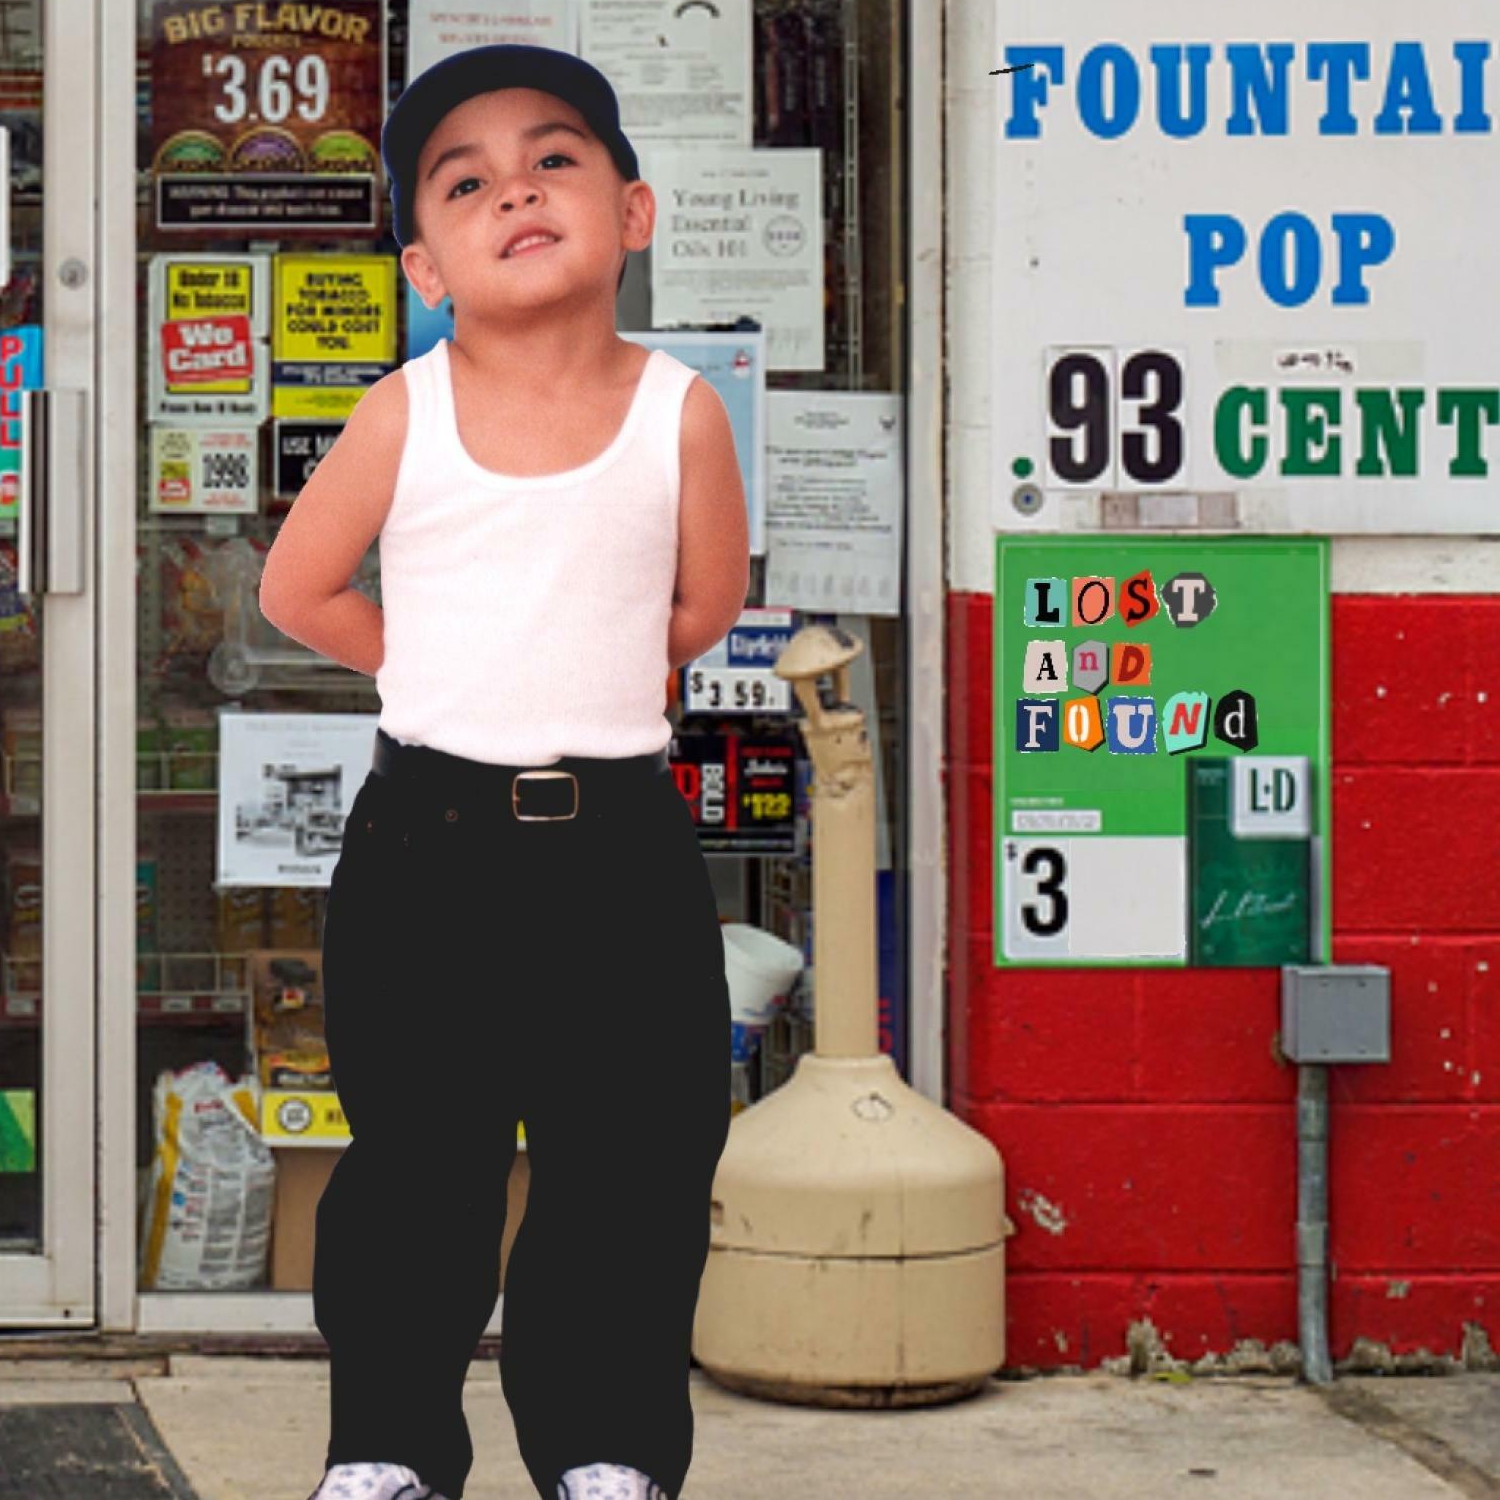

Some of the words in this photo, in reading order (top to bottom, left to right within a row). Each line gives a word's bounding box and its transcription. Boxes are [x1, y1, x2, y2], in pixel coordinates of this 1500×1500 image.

[163, 5, 225, 45] BIG
[233, 2, 371, 46] FLAVOR
[202, 53, 330, 123] $3.69
[1182, 211, 1396, 308] POP
[168, 346, 248, 373] Card
[179, 323, 234, 346] We
[1214, 385, 1500, 479] CENT
[1033, 570, 1208, 626] LOST
[702, 762, 726, 824] BOLD
